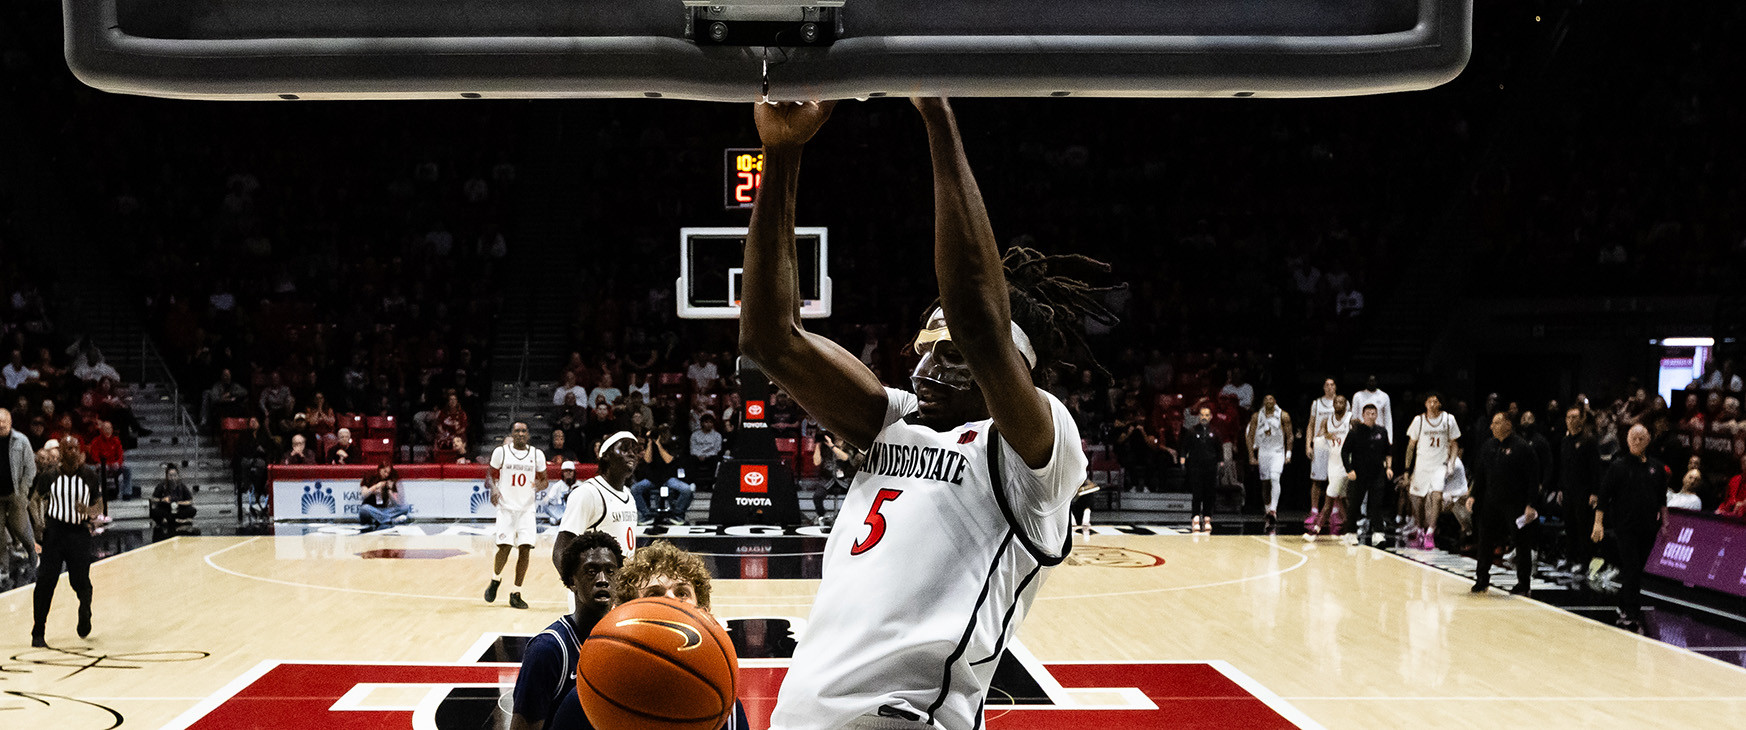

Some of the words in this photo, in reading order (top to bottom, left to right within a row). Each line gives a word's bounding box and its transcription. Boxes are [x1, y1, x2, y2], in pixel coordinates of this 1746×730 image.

[1430, 437, 1440, 447] 21
[859, 441, 882, 475] AN
[878, 443, 919, 478] DIEGO
[916, 447, 967, 486] STATE
[512, 473, 526, 487] 10
[735, 497, 772, 507] TOYOTA
[850, 488, 904, 556] 5
[626, 526, 634, 551] 0
